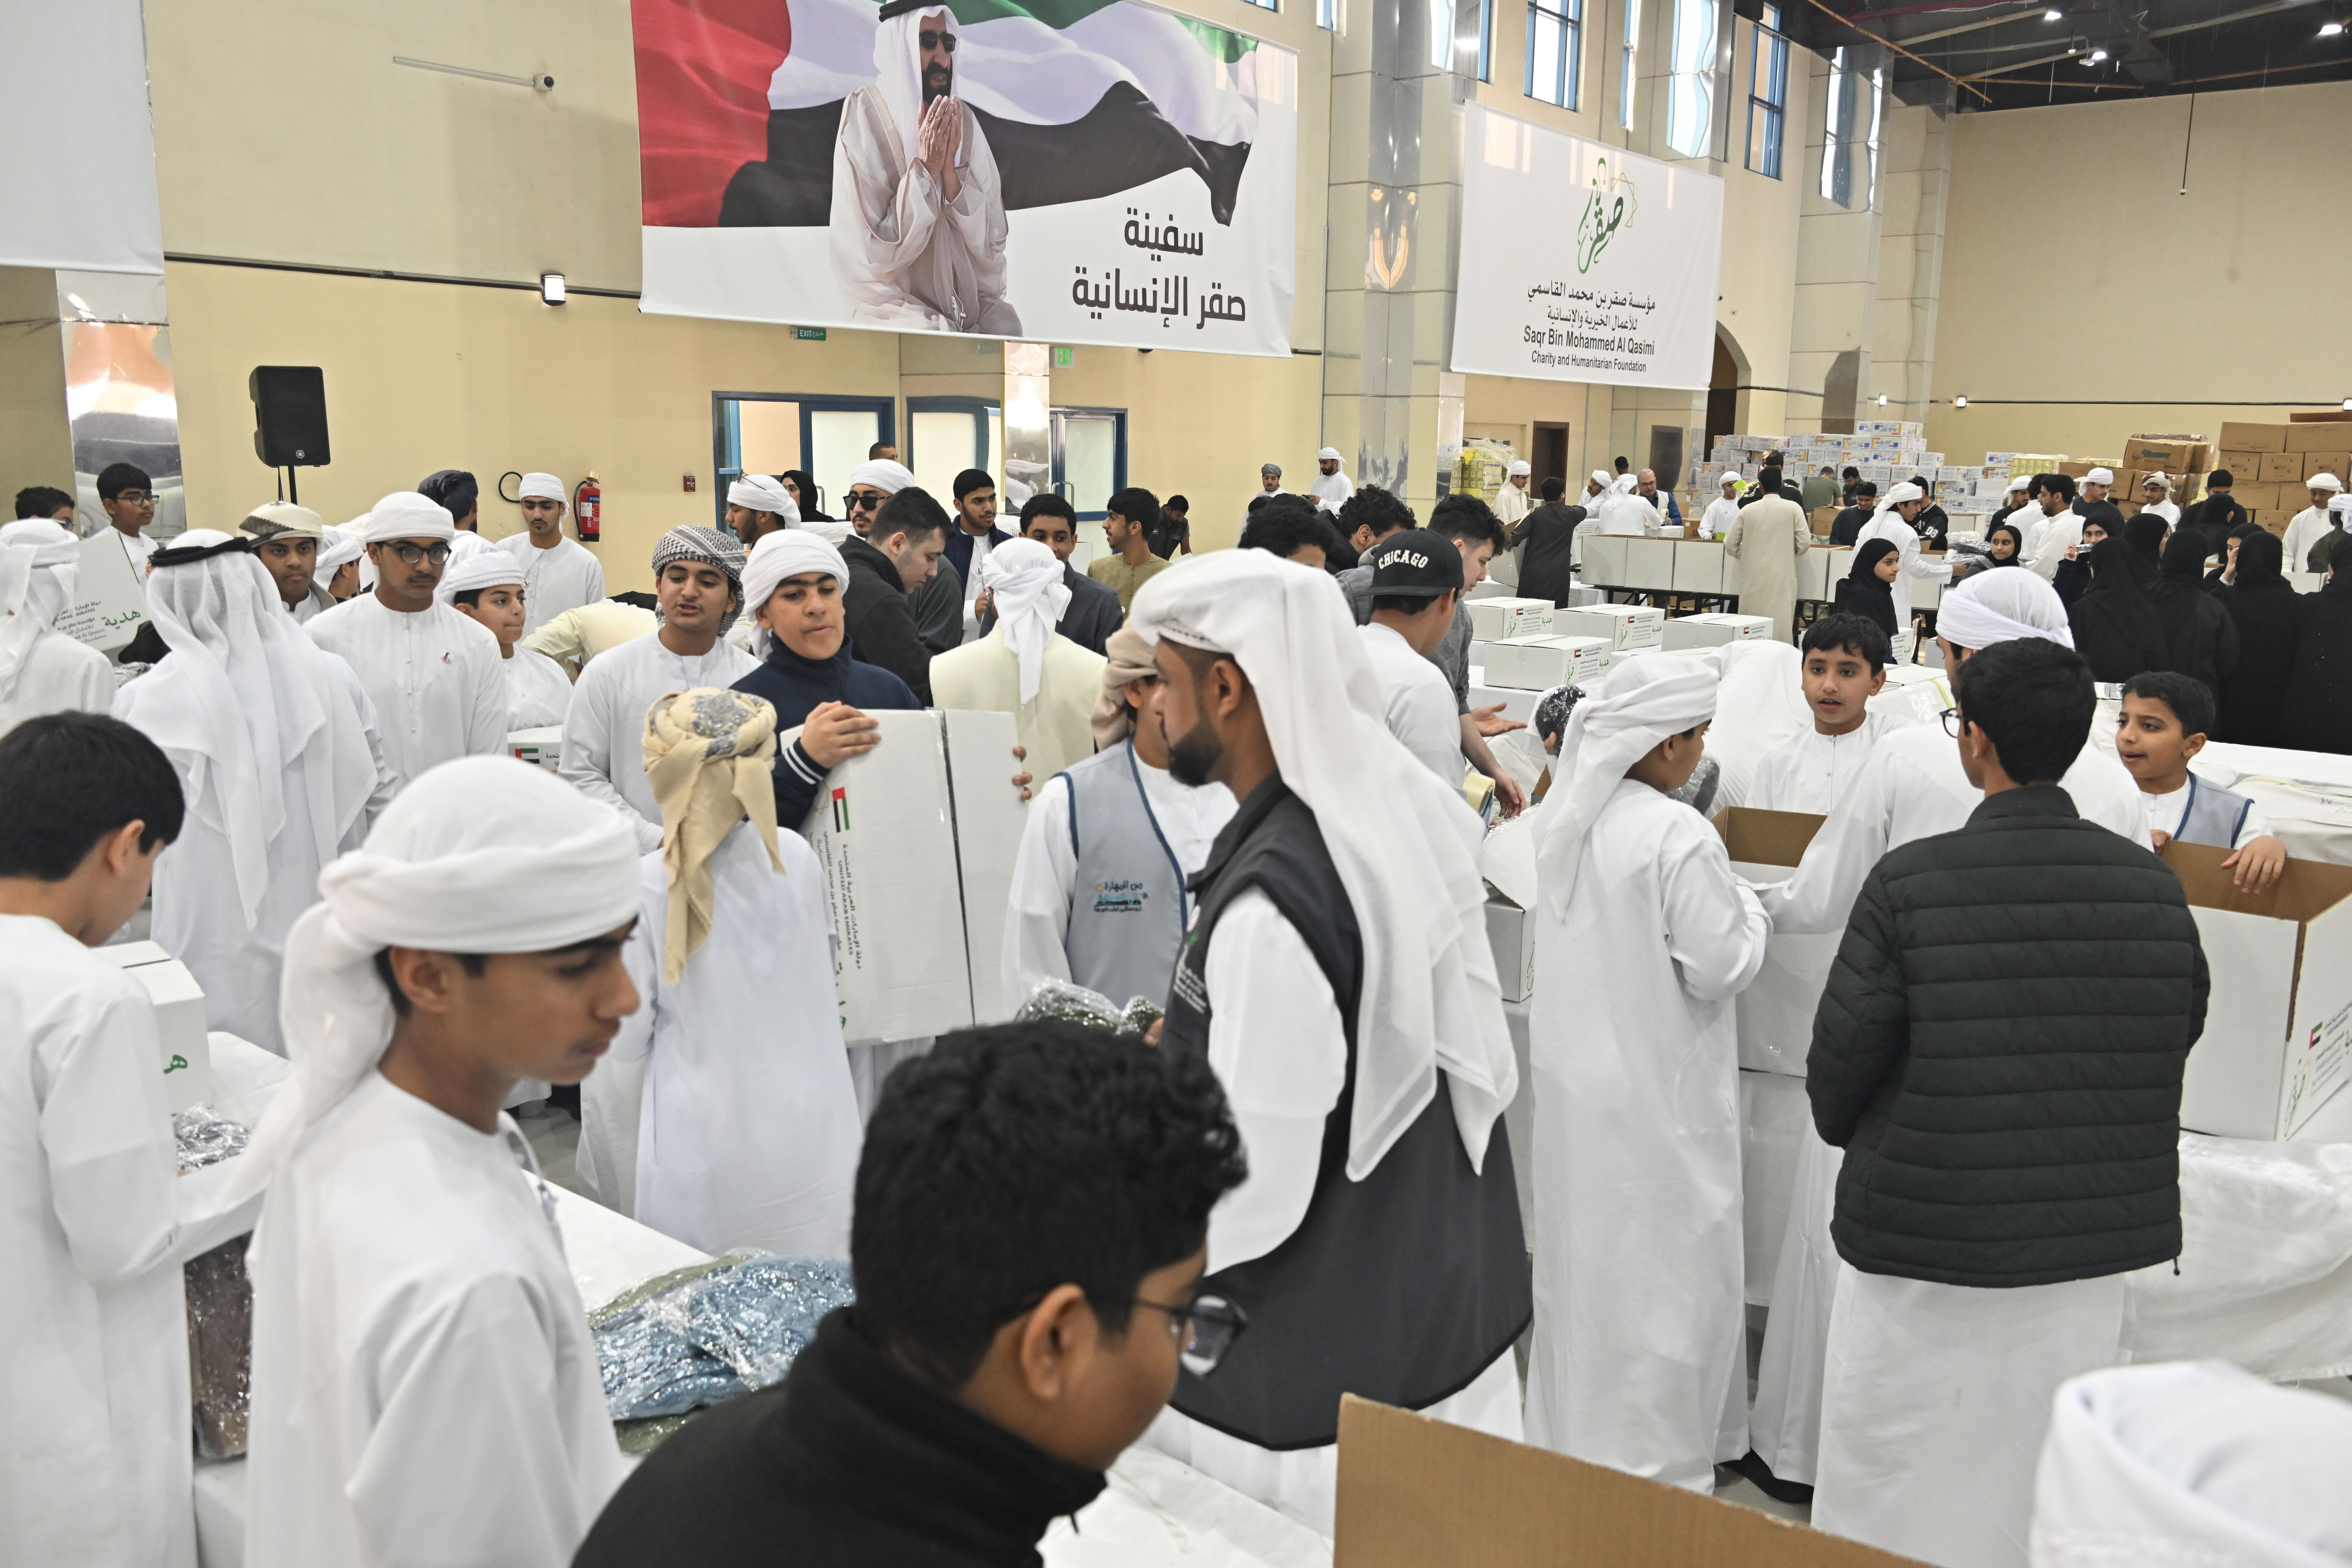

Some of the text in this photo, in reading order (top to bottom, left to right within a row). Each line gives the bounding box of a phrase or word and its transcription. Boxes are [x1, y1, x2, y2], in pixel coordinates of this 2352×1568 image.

[1125, 207, 1203, 261] سفينة
[1073, 266, 1245, 329] صقر الإنسانية
[1528, 280, 1655, 315] مؤسسة صقر بن محمد القاسمي
[1547, 306, 1637, 331] للأعمال الخيرية والإنسانية
[1524, 325, 1654, 355] Saqr Bin Mohammed Al Qasimi
[1058, 348, 1072, 365] EXIT
[1532, 350, 1646, 372] Charity and Humanitarian Foundation
[1925, 526, 1938, 538] 08
[1378, 549, 1428, 569] CHICAGO
[76, 608, 95, 616] MIRATES
[101, 610, 141, 630] هدية
[1542, 617, 1552, 626] هدية
[1652, 625, 1661, 634] هدية
[1599, 658, 1609, 670] هدية
[845, 916, 853, 955] EMIRATES
